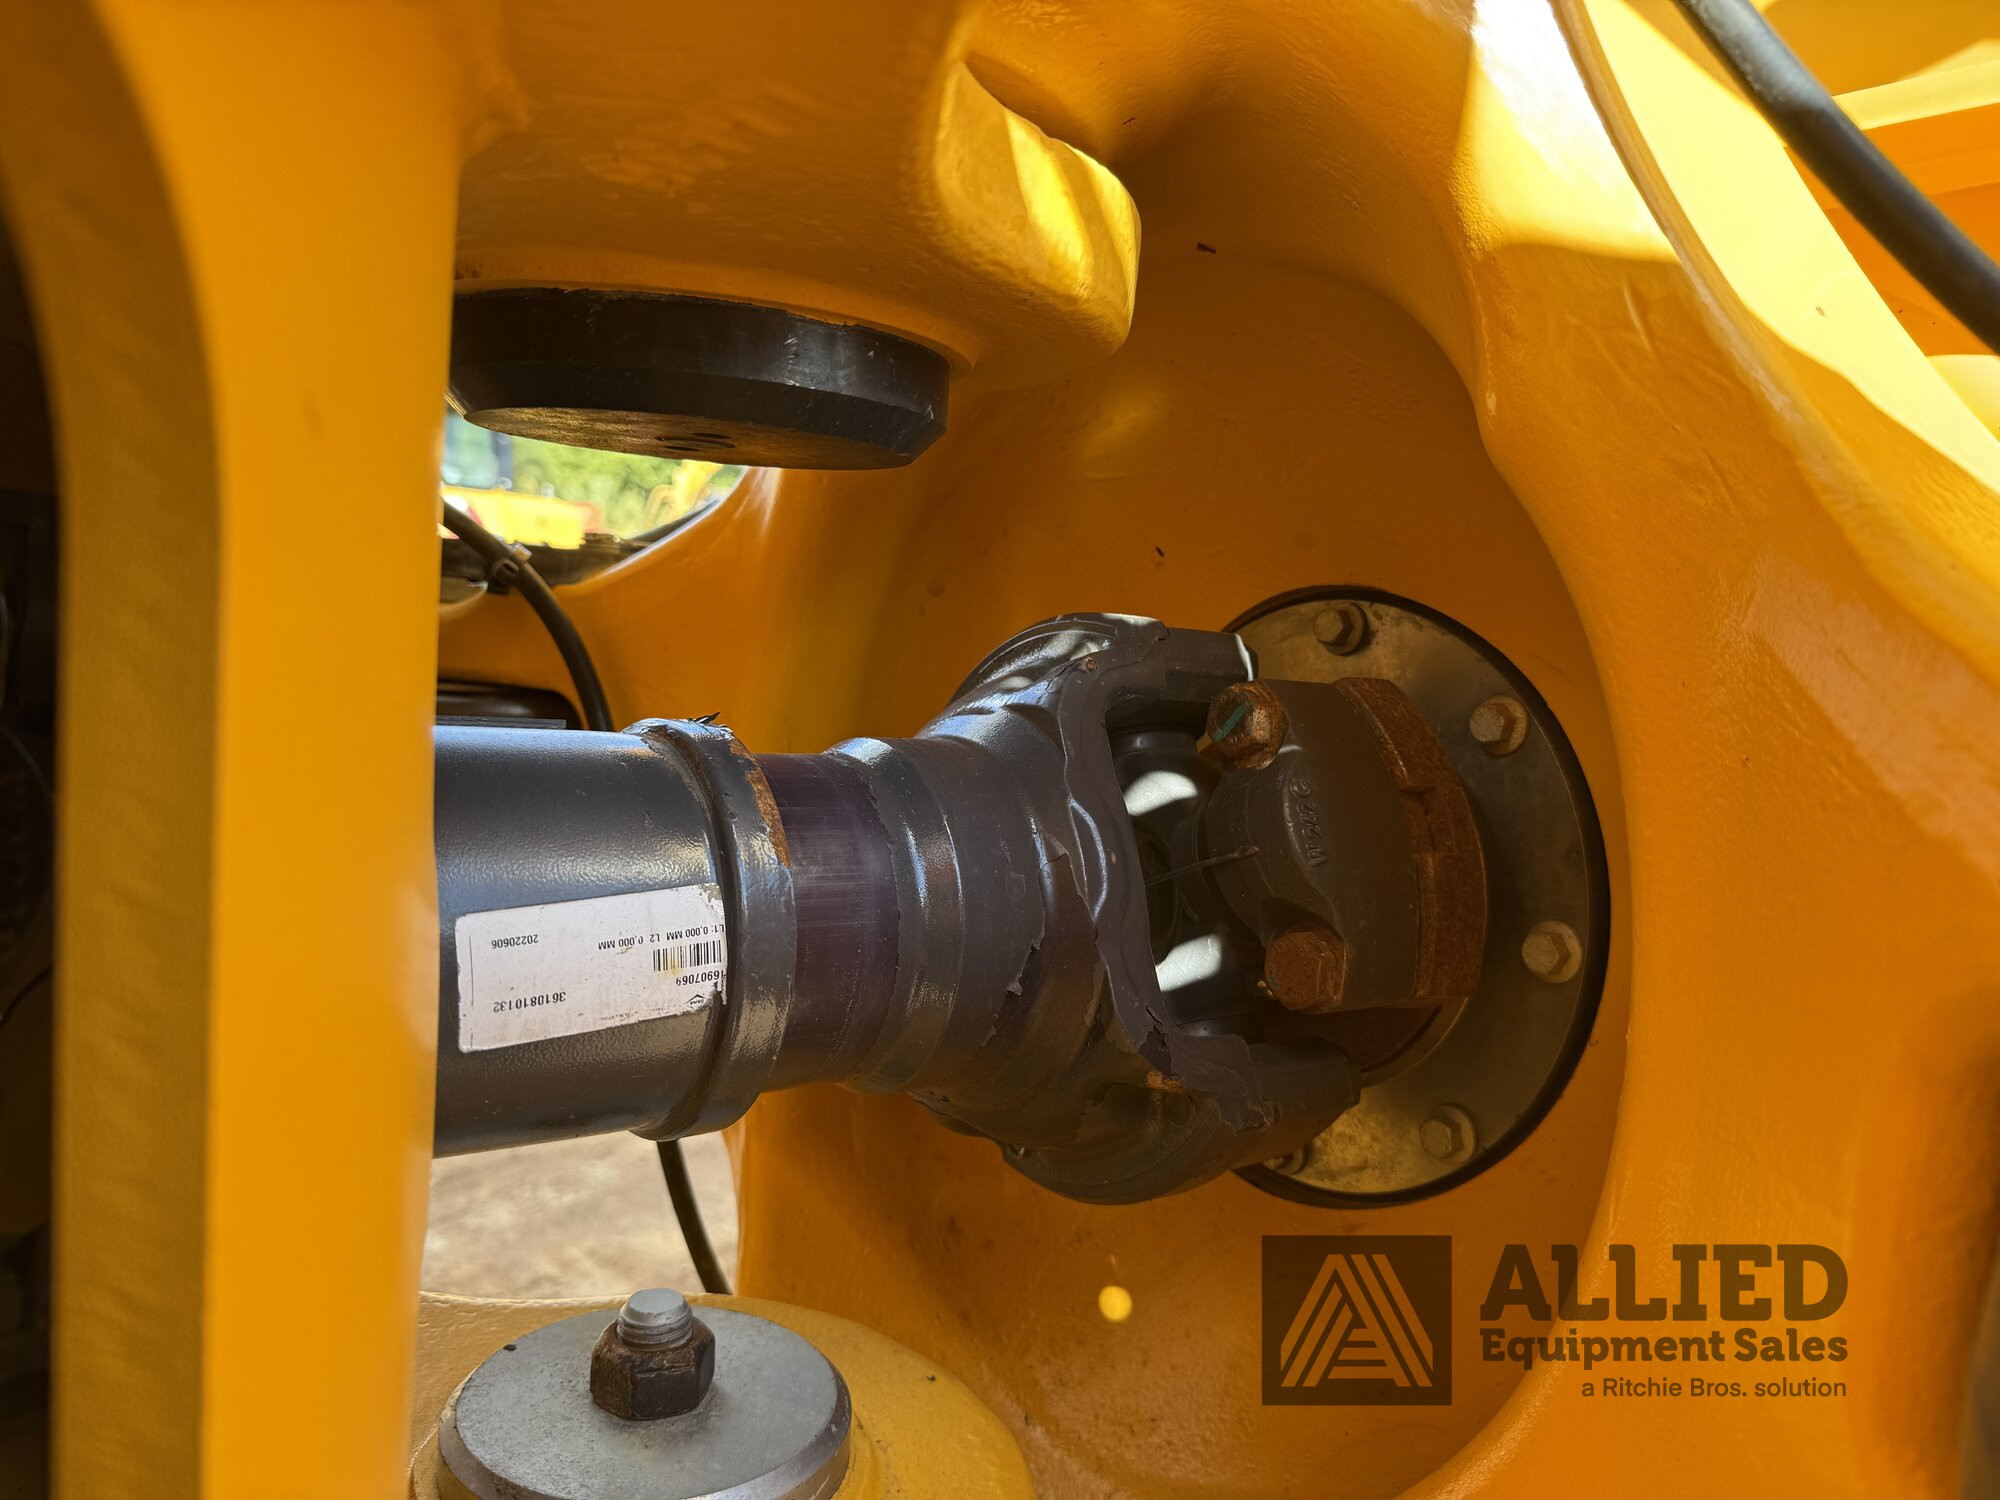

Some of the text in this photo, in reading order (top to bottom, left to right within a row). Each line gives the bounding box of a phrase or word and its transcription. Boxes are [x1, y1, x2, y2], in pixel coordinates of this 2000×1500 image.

[491, 933, 539, 950] 20220606
[666, 930, 682, 941] MM
[598, 939, 615, 950] MM
[493, 991, 567, 1013] 3610810132
